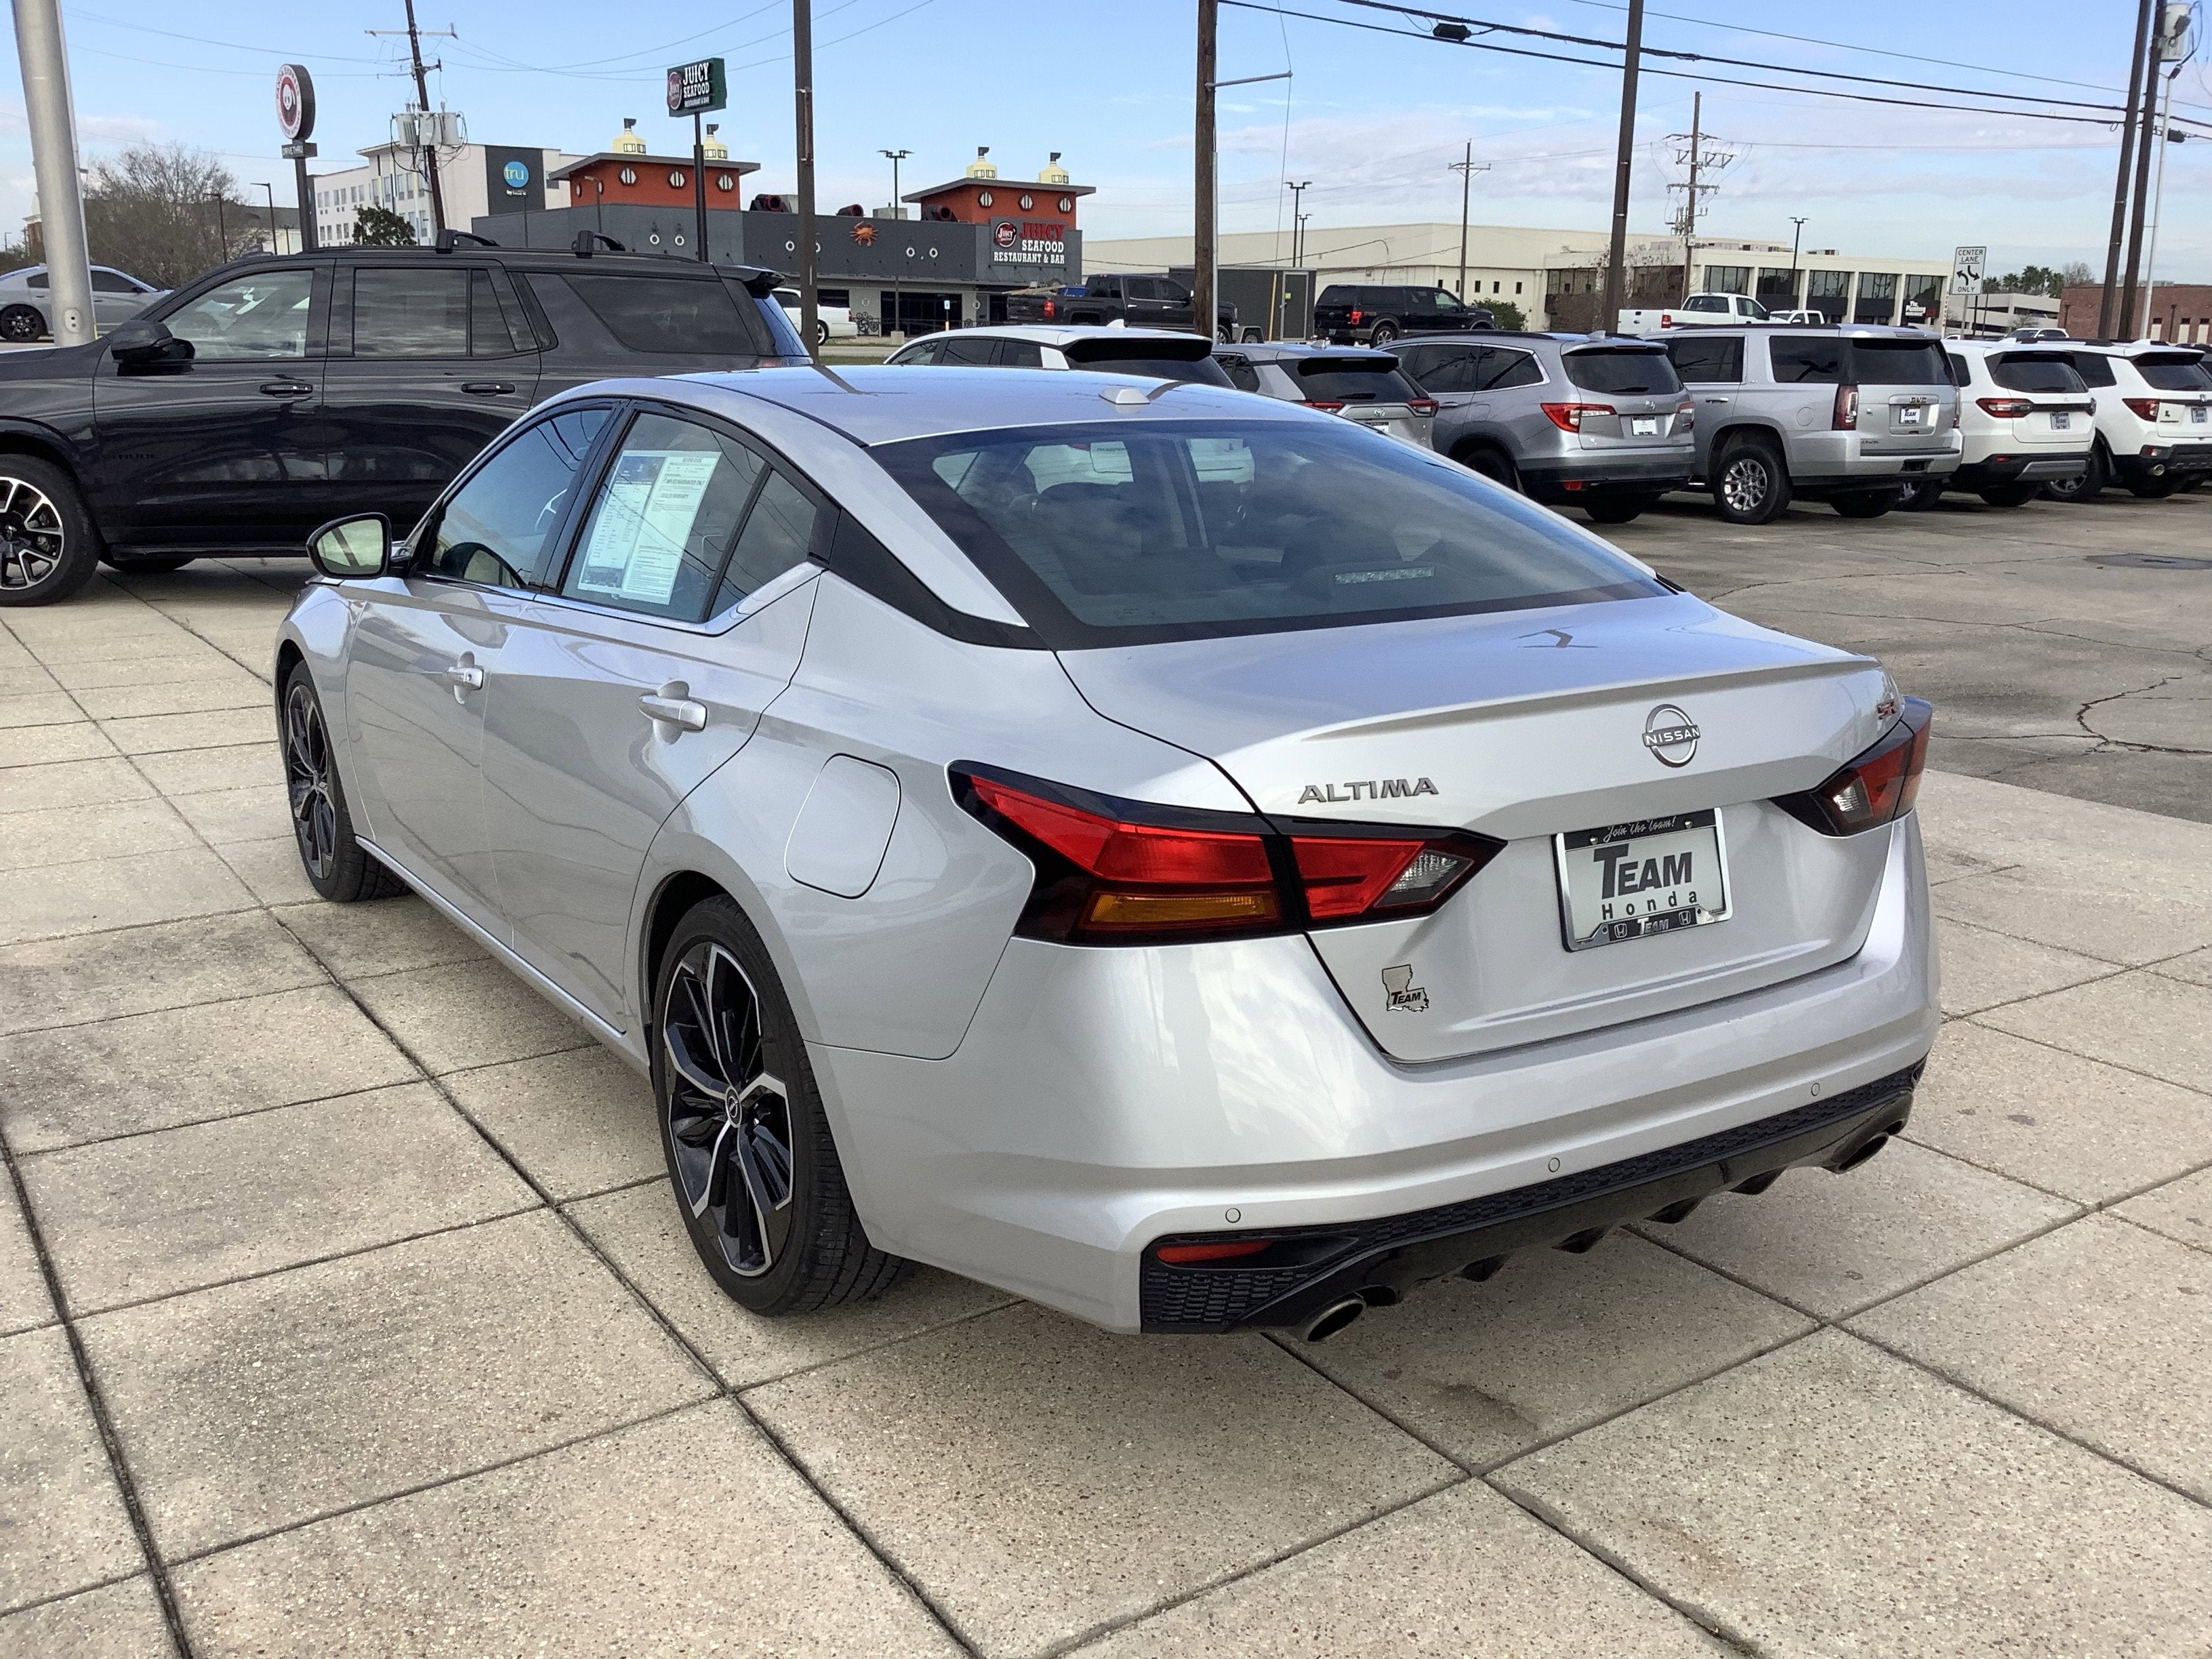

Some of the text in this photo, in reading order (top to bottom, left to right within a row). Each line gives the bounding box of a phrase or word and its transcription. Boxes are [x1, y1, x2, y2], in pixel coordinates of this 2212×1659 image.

[683, 62, 709, 85] JUICY
[683, 81, 710, 98] SEAFOOD
[504, 167, 524, 180] tru
[998, 228, 1013, 238] JUICY
[1019, 222, 1065, 241] JUICY
[1021, 239, 1064, 253] SEAFOOD
[994, 251, 1065, 264] RESTAURANT & BAR
[1645, 727, 1700, 745] NISSAN
[1298, 777, 1439, 804] ALTIMA
[1603, 825, 1628, 842] Join
[1593, 843, 1692, 899] TEAM
[1601, 890, 1698, 920] Honda
[1637, 917, 1669, 935] TEAM
[1391, 991, 1421, 1005] TEAM
